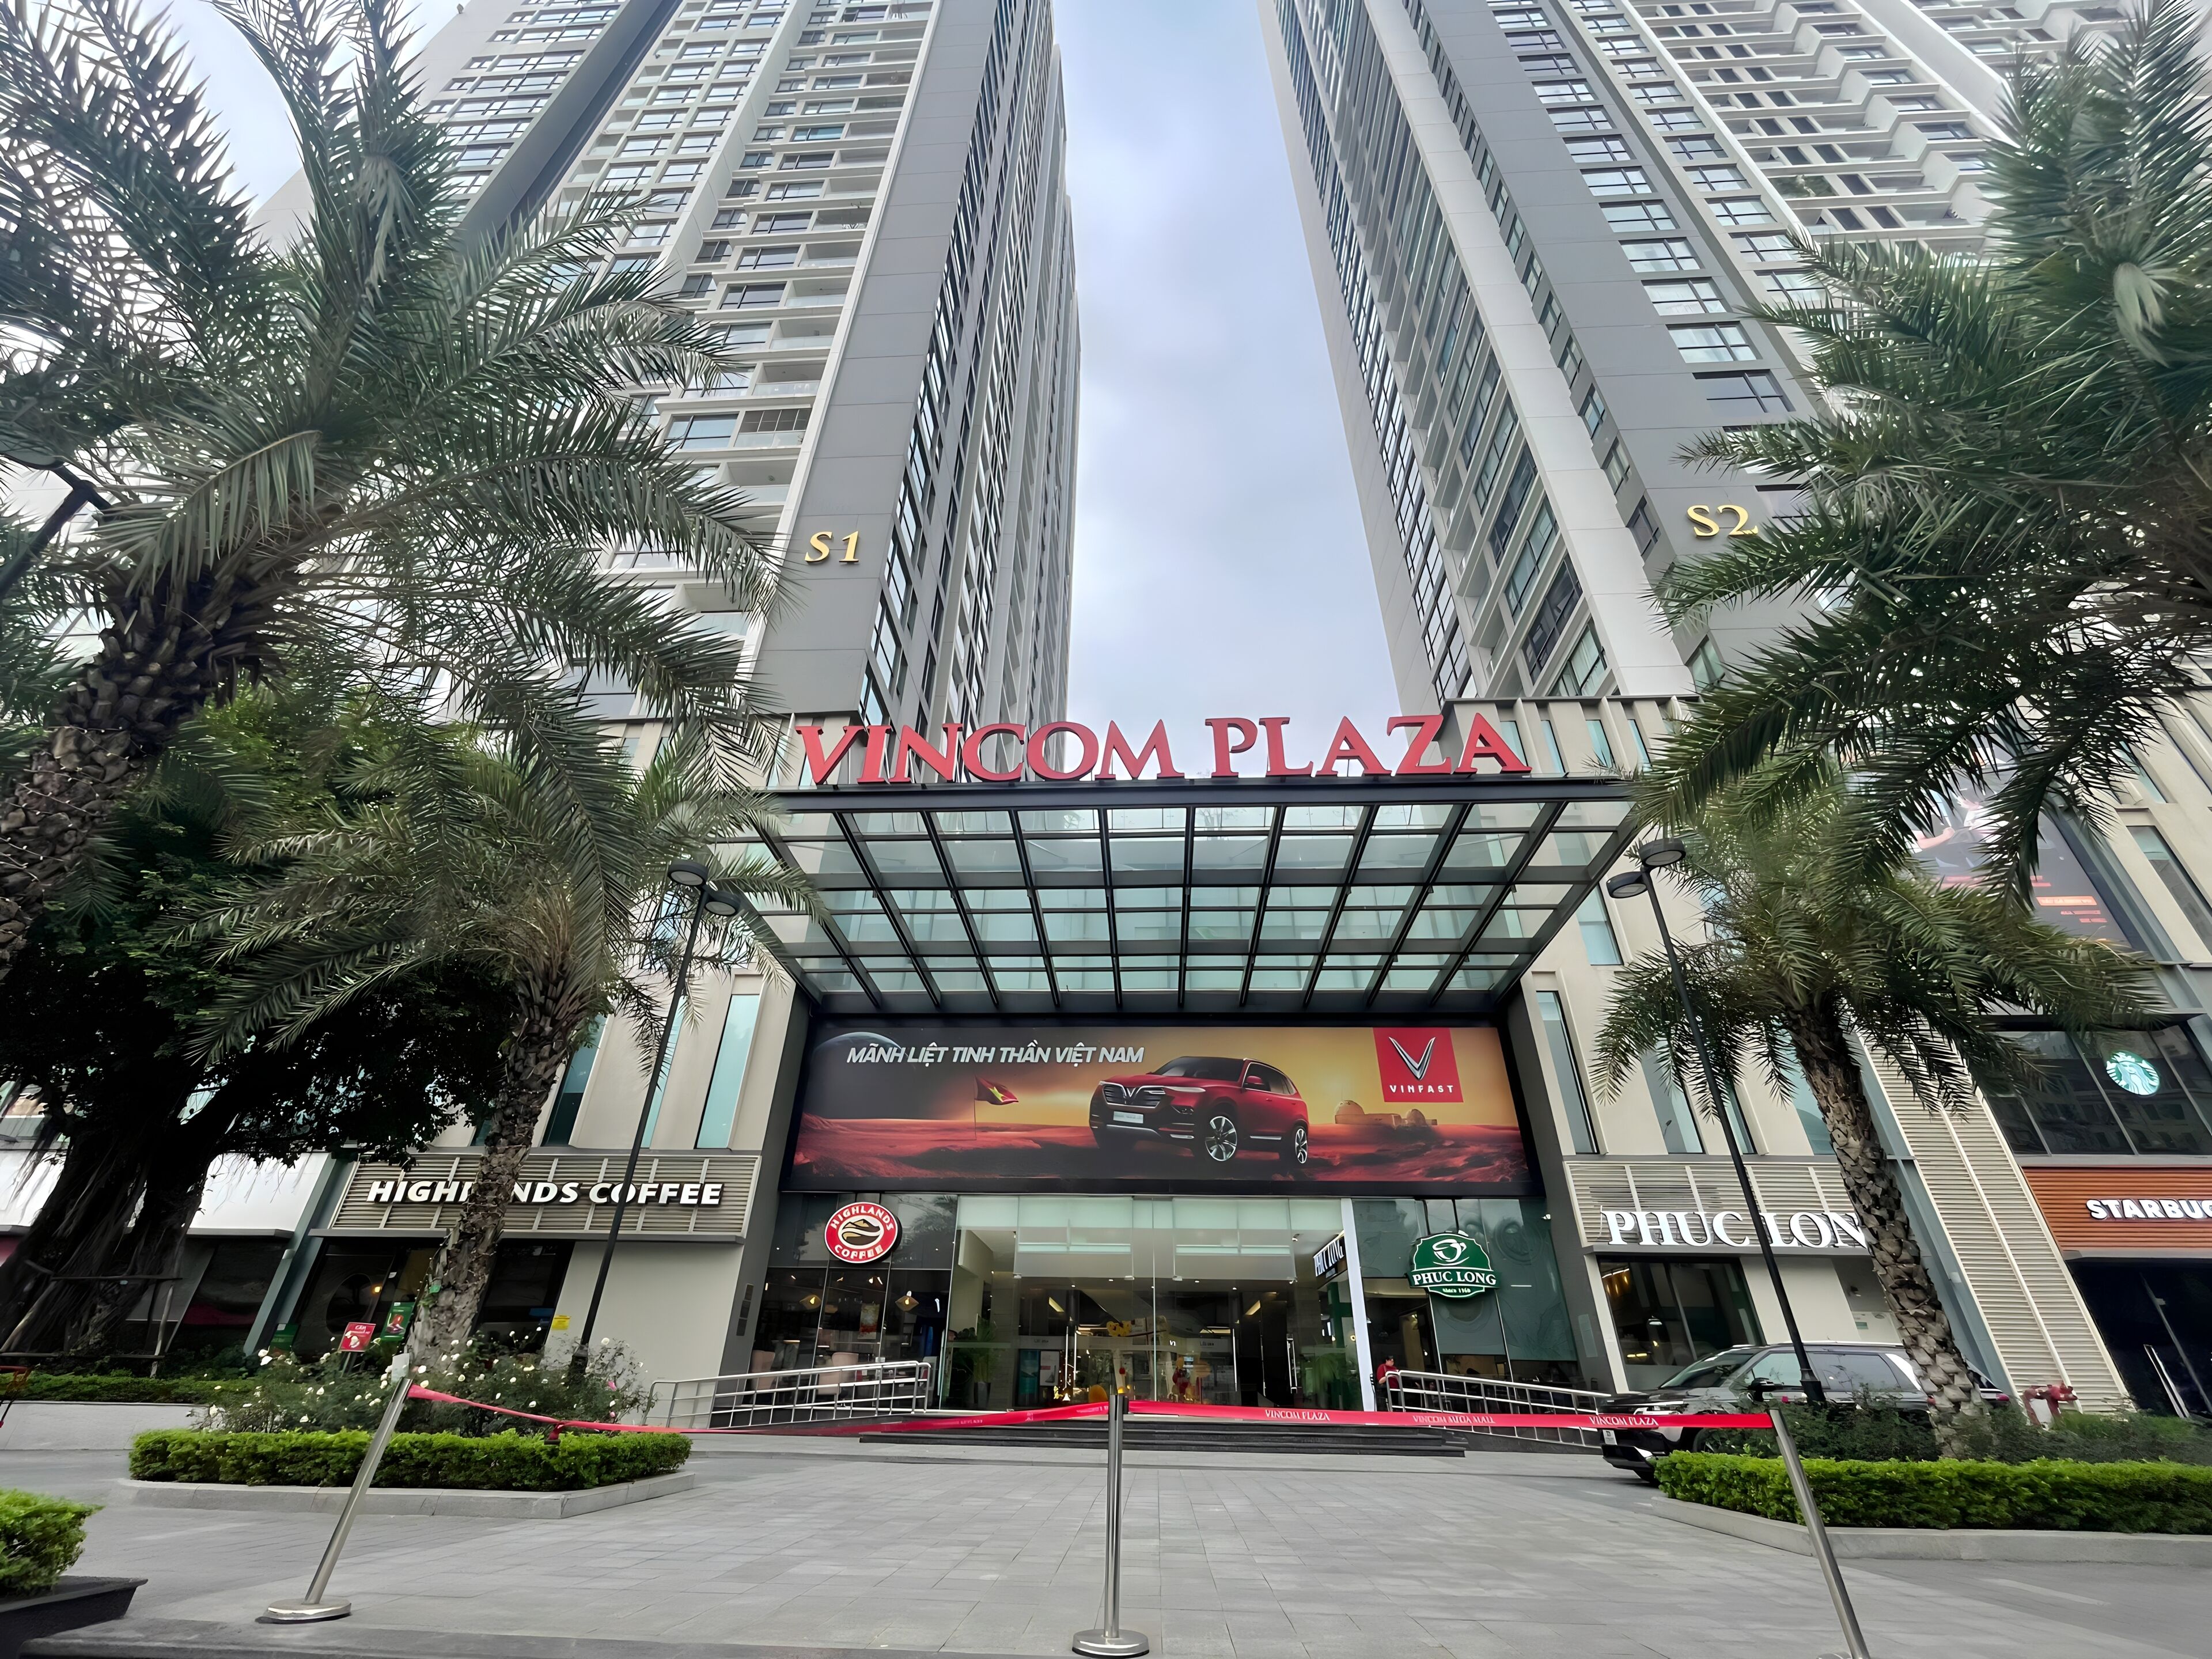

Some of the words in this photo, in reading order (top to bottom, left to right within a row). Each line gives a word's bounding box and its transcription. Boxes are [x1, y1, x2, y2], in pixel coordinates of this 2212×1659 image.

[1687, 505, 1759, 537] S2
[804, 531, 859, 563] S1
[796, 719, 1185, 785] VINCOM
[1205, 713, 1532, 777] PLAZA
[846, 1043, 906, 1063] MÃNH
[907, 1042, 949, 1067] LIỆT
[952, 1047, 995, 1063] TINH
[999, 1039, 1051, 1063] THẦN
[1055, 1041, 1096, 1067] VIỆT
[1098, 1047, 1145, 1063] NAM
[1389, 1085, 1453, 1093] VINFAST
[366, 1180, 579, 1203] HIGHLNDS
[589, 1182, 723, 1205] COFFEE
[830, 1205, 894, 1231] HIGHLANDS
[1600, 1211, 1751, 1247] PHUC
[1759, 1211, 1868, 1249] LON
[834, 1244, 884, 1260] COFFEE
[1412, 1271, 1453, 1285] PHUC
[1456, 1271, 1497, 1286] LONG
[1264, 1409, 1301, 1419] VINCOM
[1302, 1411, 1331, 1421] PLAZA
[1589, 1416, 1628, 1426] VINCOM
